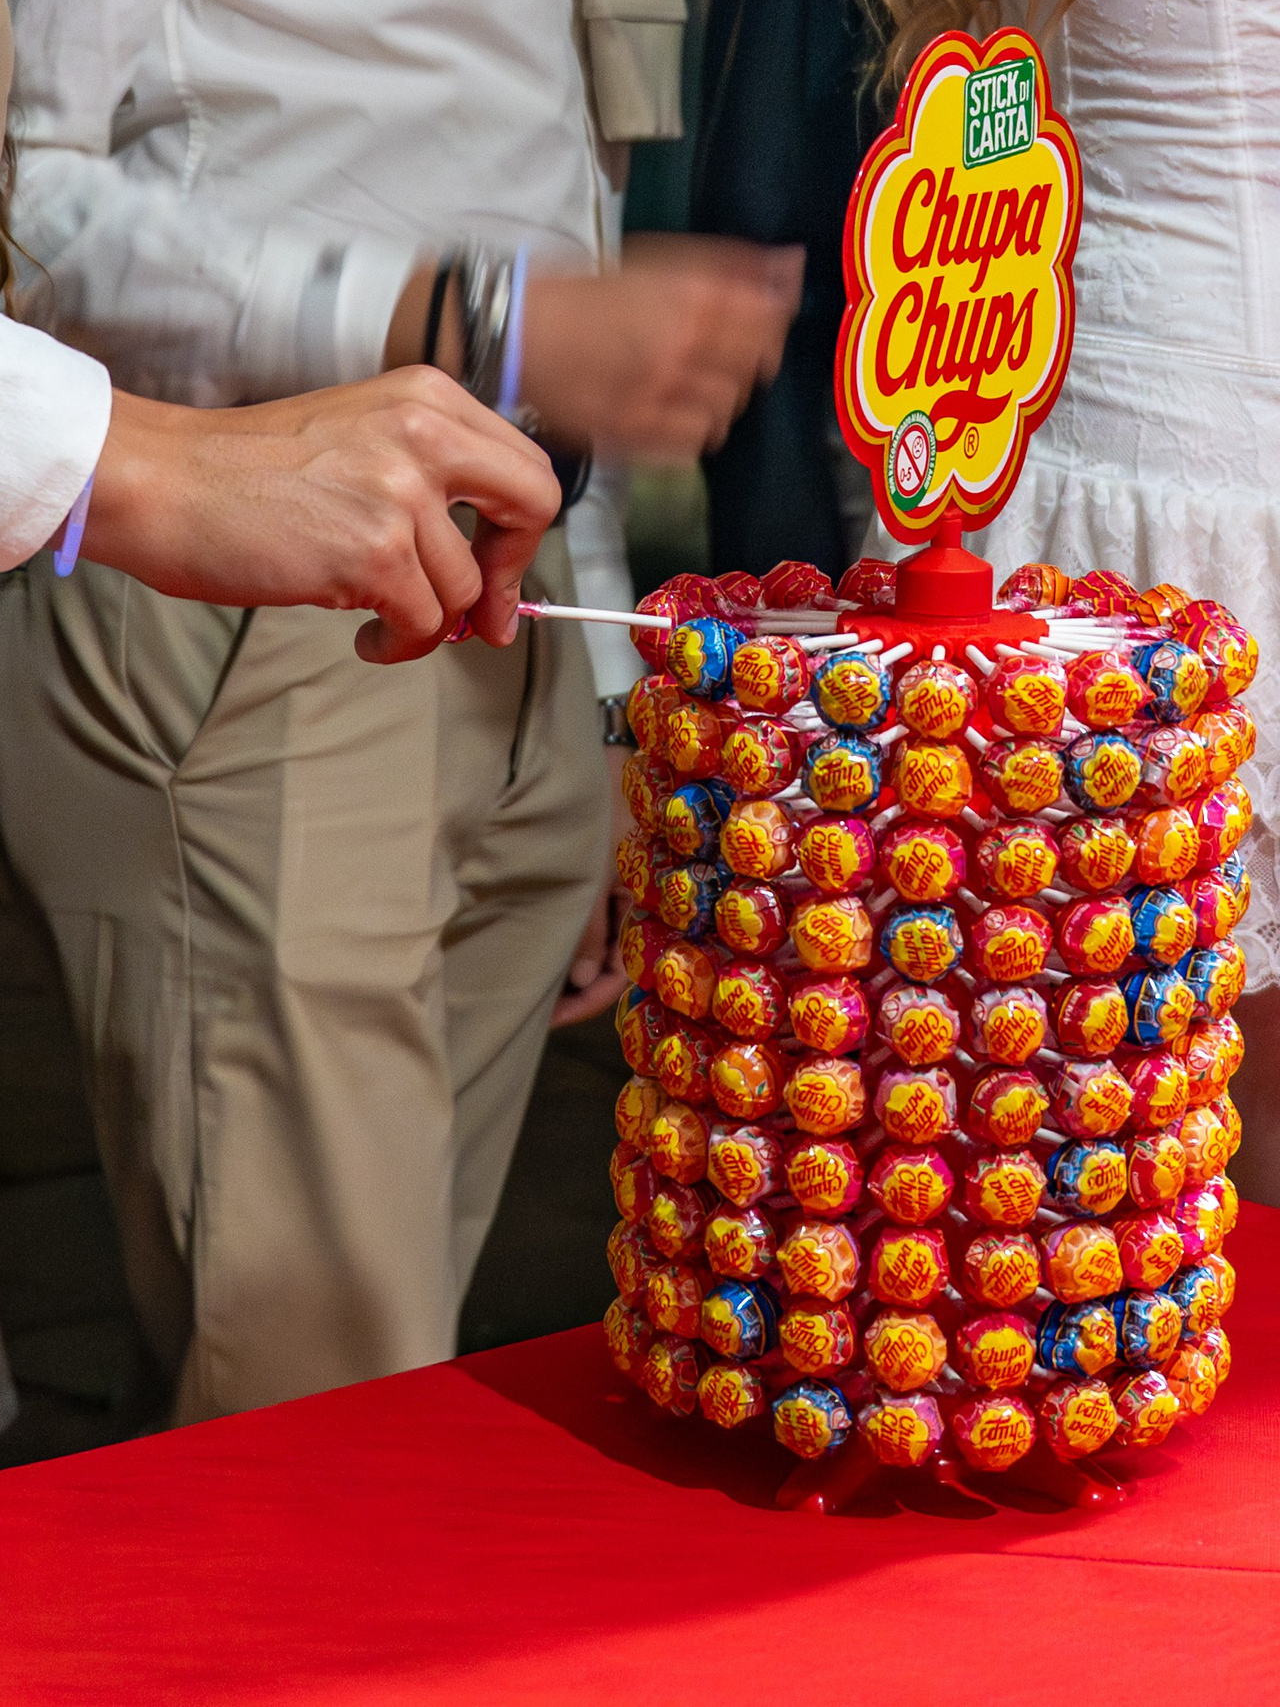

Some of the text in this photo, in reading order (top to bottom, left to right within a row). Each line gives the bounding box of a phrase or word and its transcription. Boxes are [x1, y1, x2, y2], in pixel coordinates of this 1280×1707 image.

[969, 70, 1030, 117] STICK DI
[969, 104, 1029, 158] CARTA
[892, 166, 1052, 293] Chupa
[875, 275, 1039, 452] Chups
[900, 466, 912, 483] 0-5
[1023, 681, 1062, 719] Chups
[917, 766, 953, 807] Chupa
[1090, 752, 1131, 791] Chups
[828, 832, 844, 882] Chupa
[1093, 919, 1123, 964] Chupa
[1091, 1001, 1120, 1047] Chupa
[977, 1359, 1027, 1386] Chups
[978, 1344, 1026, 1365] Chupa
[980, 1416, 1027, 1440] Chups
